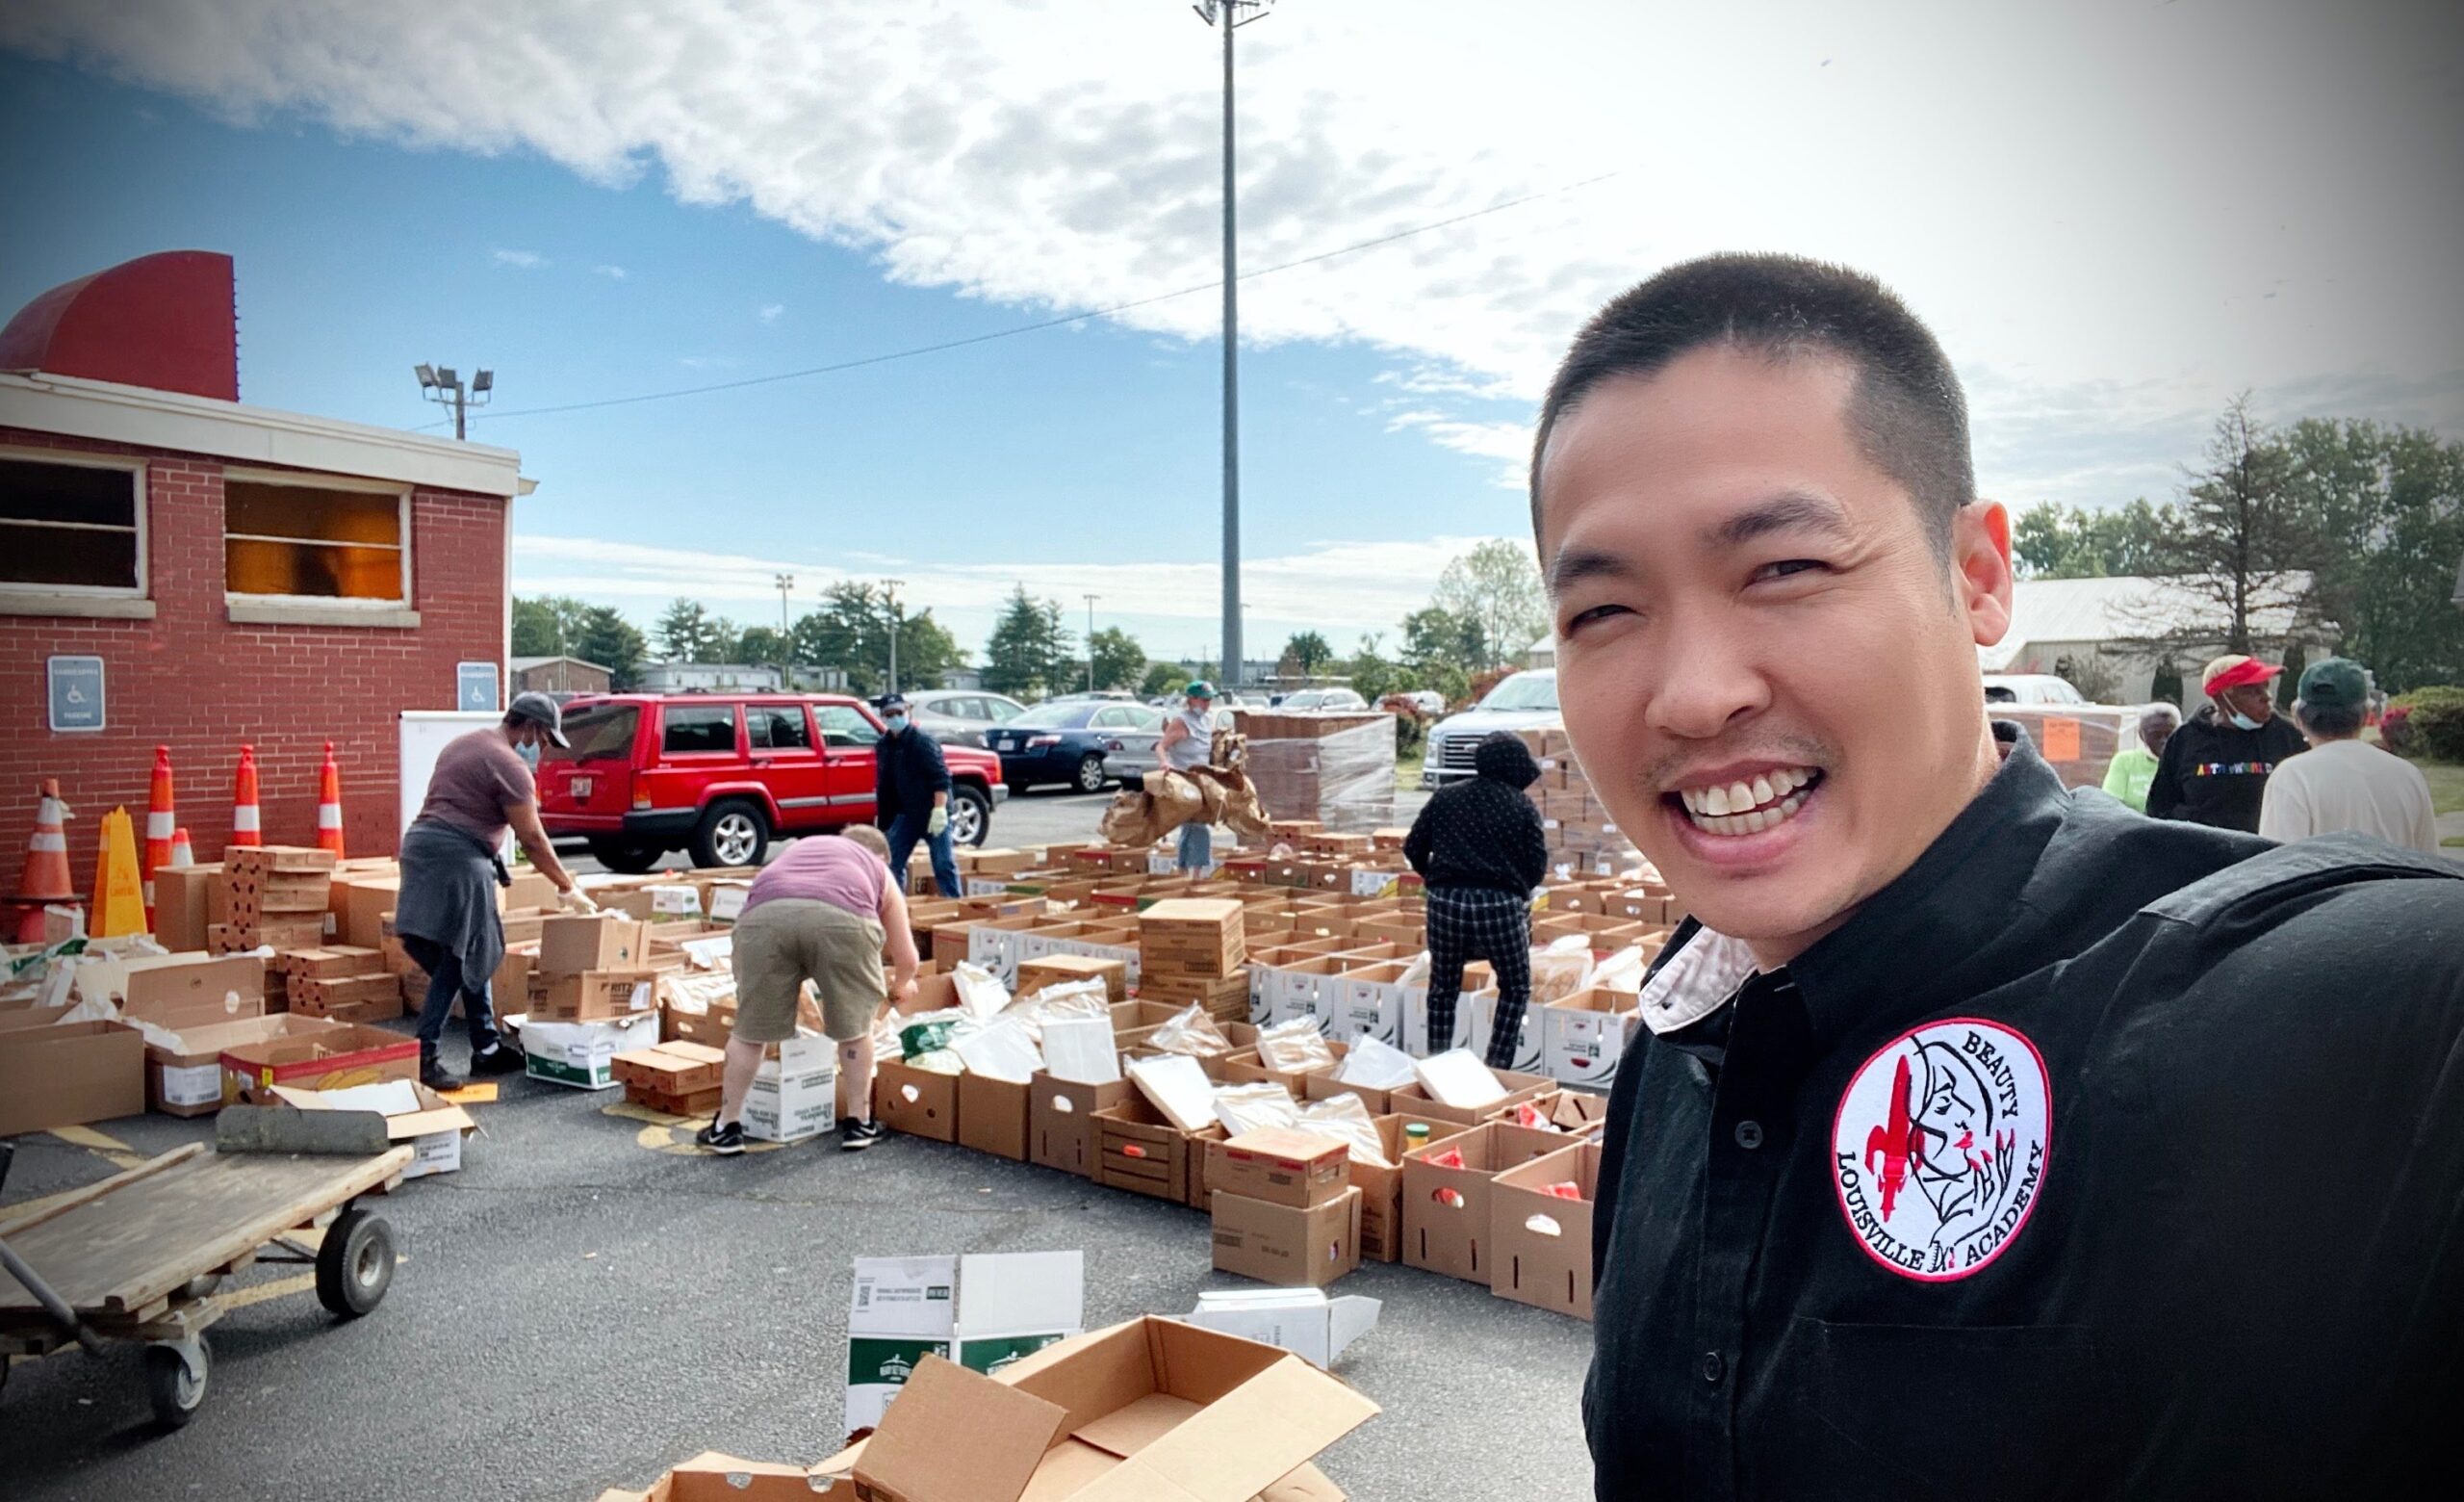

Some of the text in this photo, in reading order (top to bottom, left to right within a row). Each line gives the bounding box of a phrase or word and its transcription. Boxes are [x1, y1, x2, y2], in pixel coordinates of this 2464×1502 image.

[1963, 1031, 2018, 1119] BEAUTY
[1837, 1140, 2044, 1271] LOUISVILLE ACADEMY
